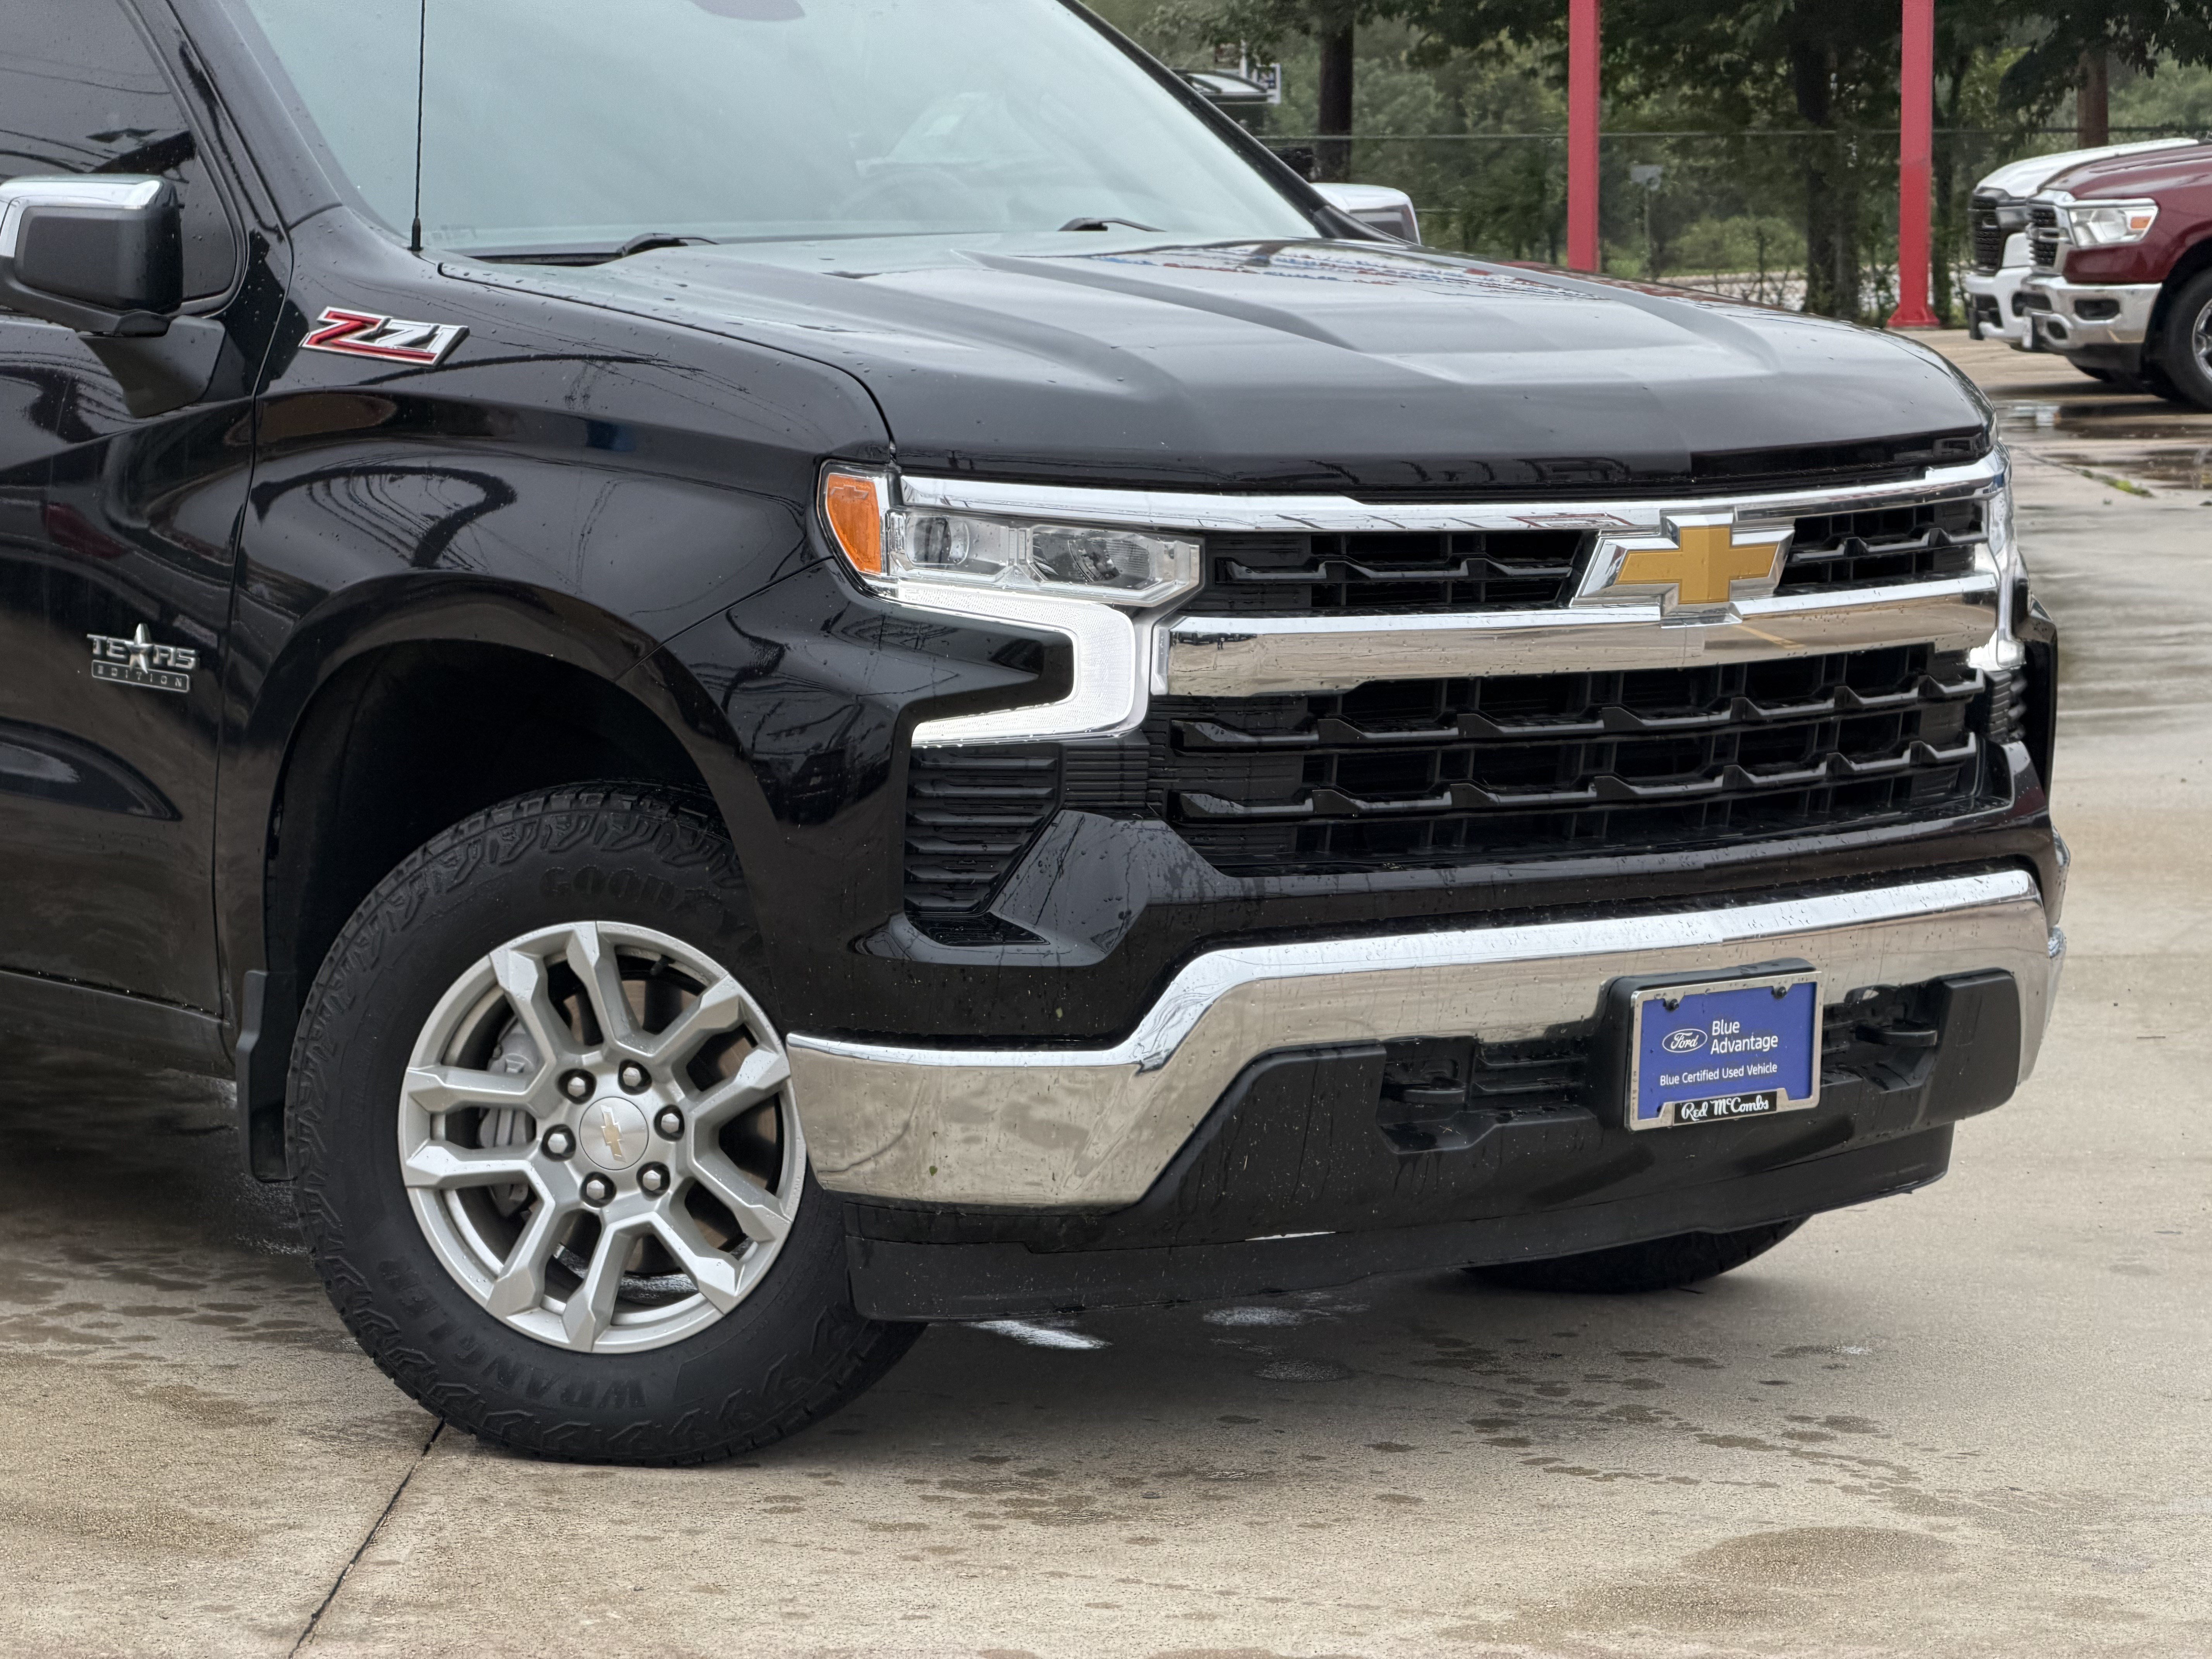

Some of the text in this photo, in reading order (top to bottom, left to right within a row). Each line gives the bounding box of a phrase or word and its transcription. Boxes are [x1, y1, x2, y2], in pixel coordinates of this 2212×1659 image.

[299, 306, 469, 366] Z71
[87, 623, 196, 673] TEXAS
[98, 665, 182, 687] EDITION
[1712, 1019, 1740, 1036] Blue
[1670, 1032, 1698, 1049] Ford
[1710, 1032, 1779, 1055] Advantage
[1660, 1062, 1778, 1086] Blue Certified Used Vehicle
[1681, 1094, 1769, 1121] Red McCombs
